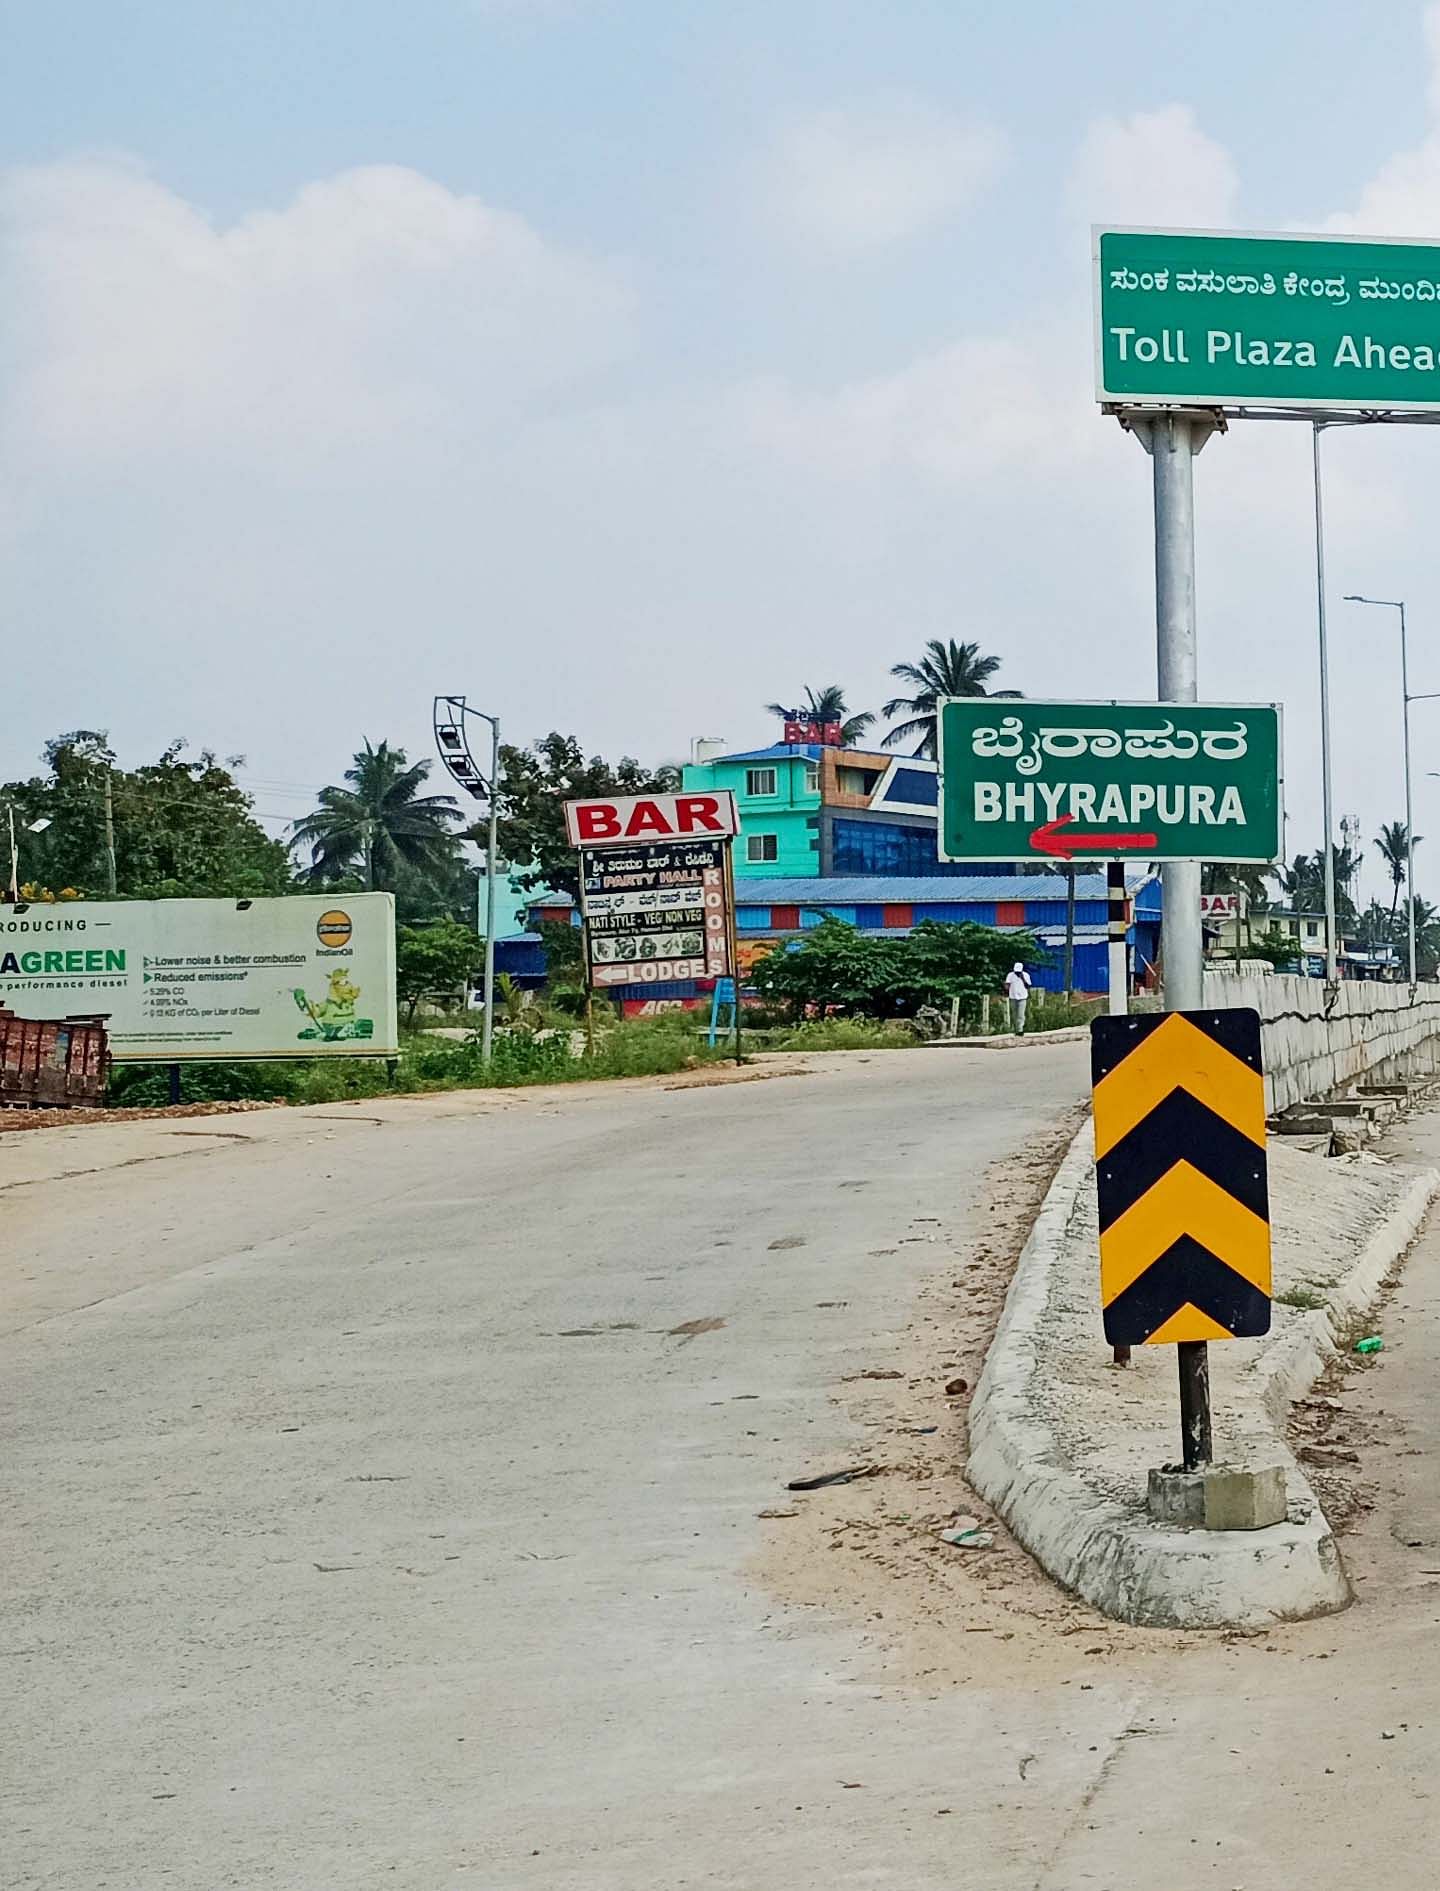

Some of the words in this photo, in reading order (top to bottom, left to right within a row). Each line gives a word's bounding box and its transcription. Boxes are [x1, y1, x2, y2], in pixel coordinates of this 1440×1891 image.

[1110, 267, 1169, 291] ಸುಂಕ
[1176, 269, 1276, 295] ವಸುಲಾತಿ
[1283, 271, 1350, 306] ಕೇಂದ್ರ
[1110, 327, 1189, 363] Toll
[1207, 331, 1317, 367] Plaza
[784, 722, 841, 744] BAR
[972, 716, 1248, 775] ಬೈರಾಪುರ
[576, 797, 725, 839] BAR
[973, 781, 1247, 825] BHYRAPURA
[603, 872, 656, 888] PARTY
[659, 869, 703, 883] HALL
[589, 917, 608, 929] NATI
[666, 910, 683, 922] NON
[685, 909, 702, 921] VEG
[705, 869, 725, 975] ROOMS
[155, 955, 184, 966] Lower
[186, 955, 211, 966] noise
[213, 955, 221, 965] &
[223, 954, 251, 965] better
[253, 953, 306, 964] combustion
[7, 979, 84, 991] performance
[90, 978, 128, 988] diesel
[154, 972, 195, 982] Reduced
